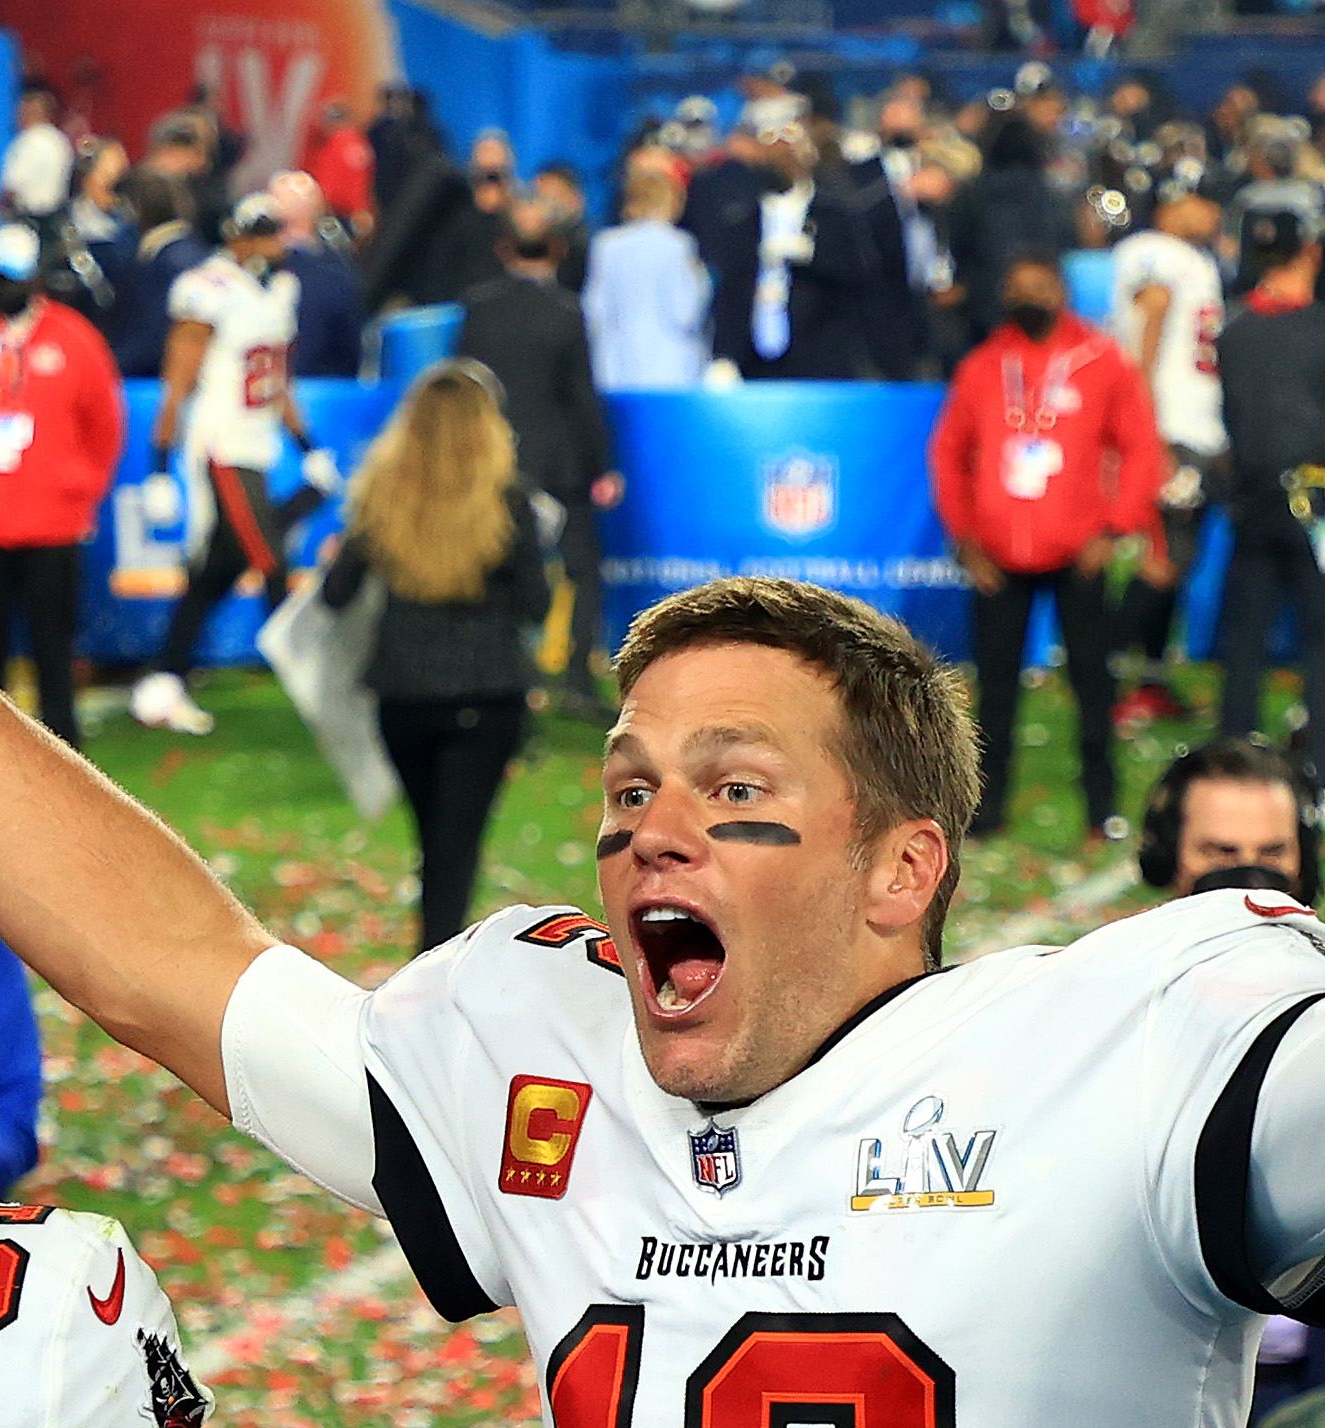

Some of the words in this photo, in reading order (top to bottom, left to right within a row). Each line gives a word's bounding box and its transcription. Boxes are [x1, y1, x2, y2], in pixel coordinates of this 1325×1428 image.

[509, 1084, 580, 1166] C
[697, 1153, 734, 1184] NFL
[635, 1235, 831, 1286] BUCCANEERS
